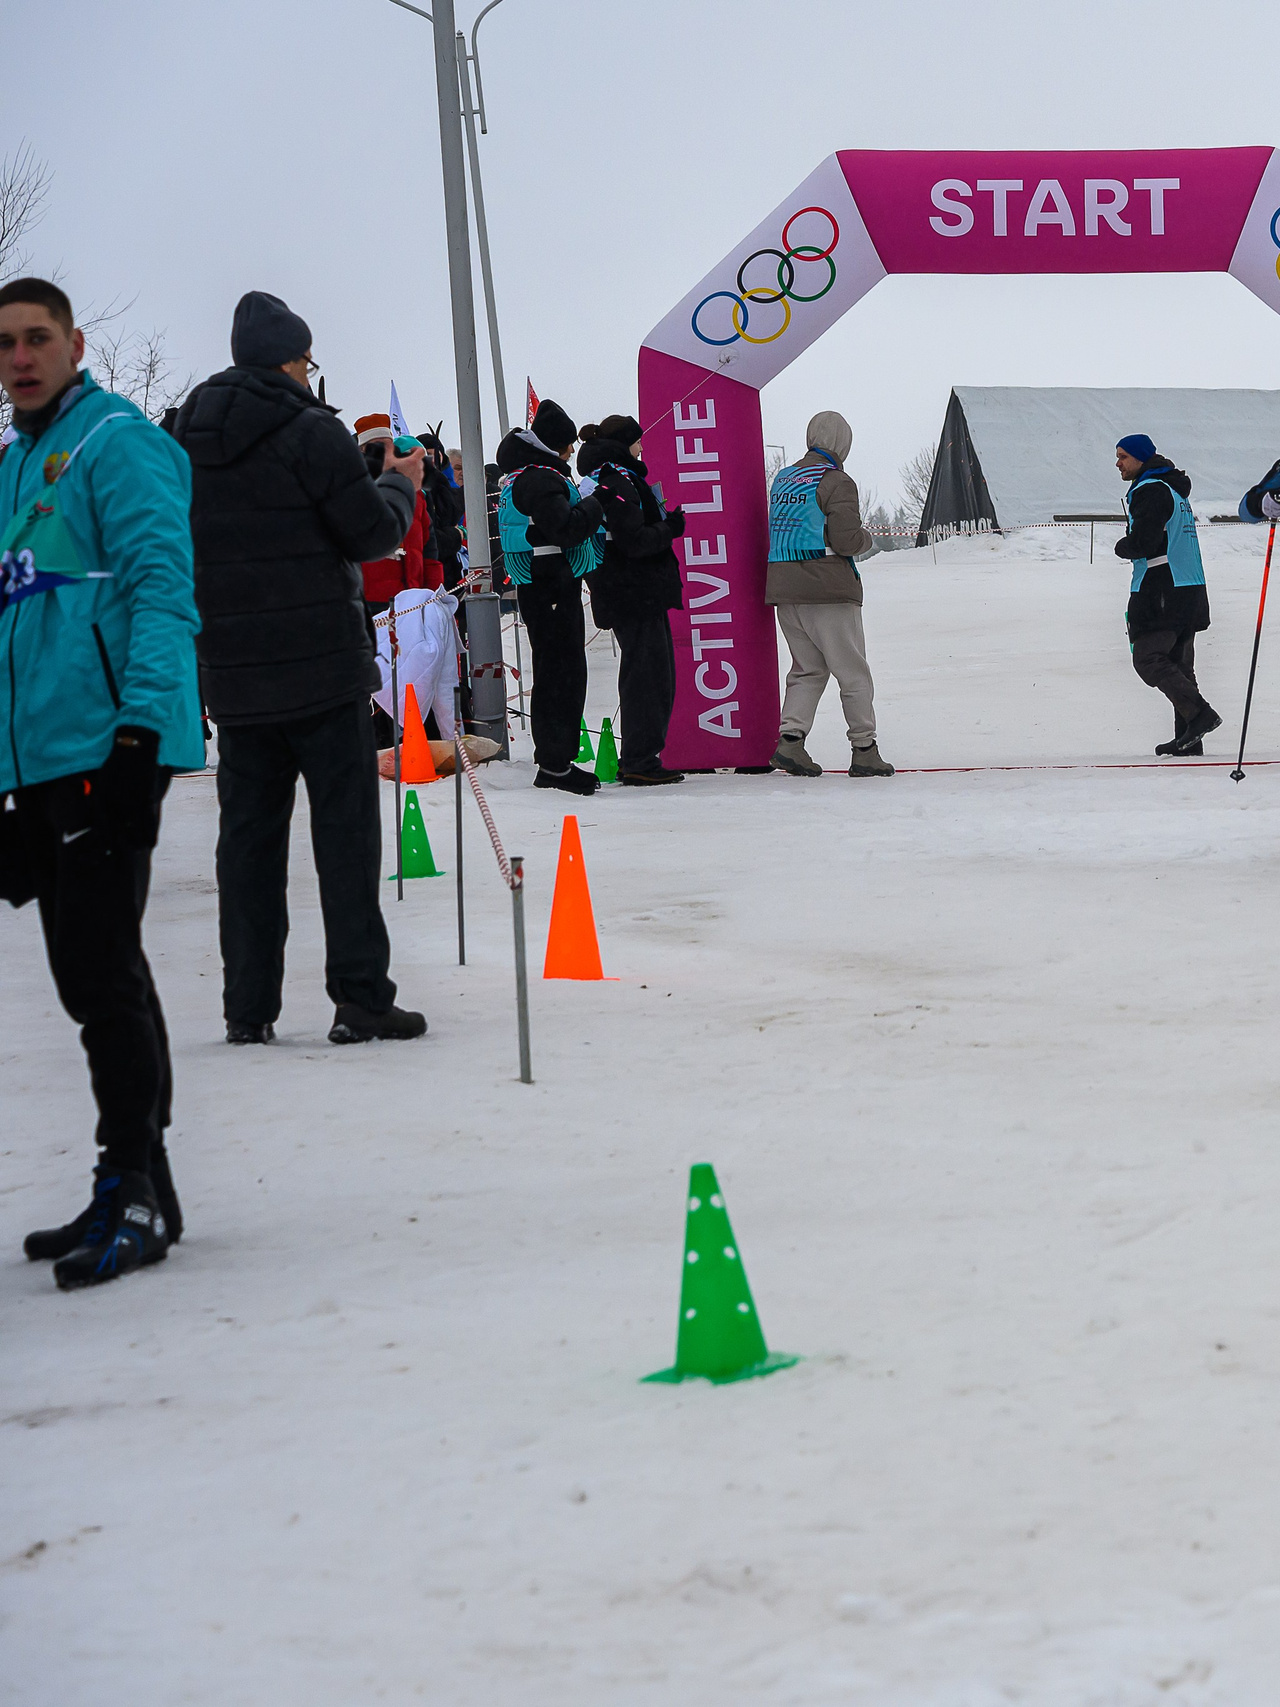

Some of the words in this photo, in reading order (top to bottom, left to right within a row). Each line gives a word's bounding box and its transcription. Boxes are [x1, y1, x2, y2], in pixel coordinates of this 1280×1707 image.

[929, 177, 1180, 237] START
[673, 398, 723, 514] LIFE
[770, 491, 807, 506] СУДЬЯ
[684, 534, 742, 738] ACTIVE
